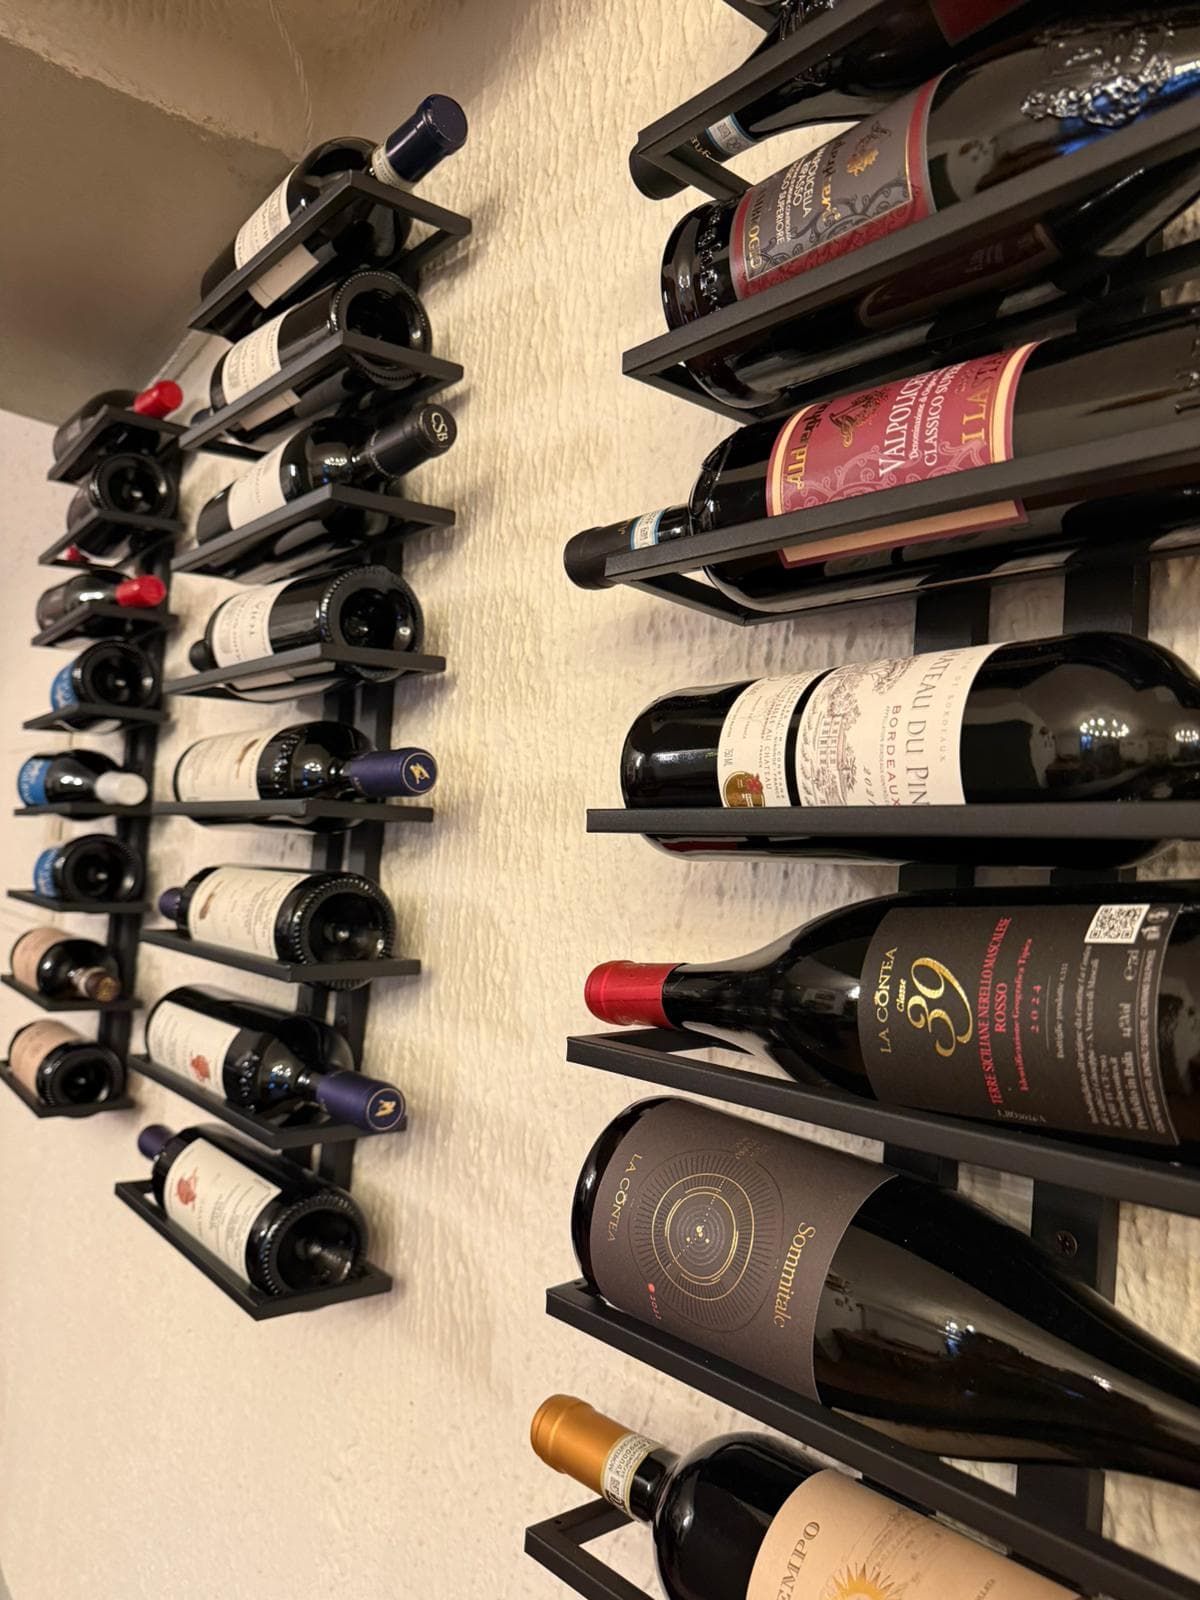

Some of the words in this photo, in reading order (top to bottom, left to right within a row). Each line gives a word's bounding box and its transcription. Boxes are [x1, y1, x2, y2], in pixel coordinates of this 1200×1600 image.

[777, 191, 793, 246] SUPERIORE
[431, 412, 449, 442] CSB
[924, 395, 945, 467] CLASSICO
[962, 431, 986, 444] I
[911, 650, 960, 710] HATEAU
[886, 704, 902, 806] BORDEAUX
[905, 719, 927, 754] DU
[906, 765, 931, 806] PIN
[979, 916, 1012, 969] MASCALESE
[1017, 937, 1033, 966] Tipica
[874, 946, 898, 1024] CONTEA
[896, 978, 908, 1013] Classe
[906, 956, 974, 1057] 39
[976, 970, 993, 1018] NERELLO
[995, 982, 1008, 1033] ROSSO
[1013, 966, 1027, 1018] Geografica
[878, 1028, 892, 1053] LA
[978, 1019, 995, 1072] SICILIANE
[1012, 1018, 1030, 1092] Identificazione
[1121, 1050, 1135, 1077] Italia
[984, 1072, 1004, 1104] TERRE
[625, 1153, 643, 1173] LA
[607, 1177, 631, 1242] CONTEA
